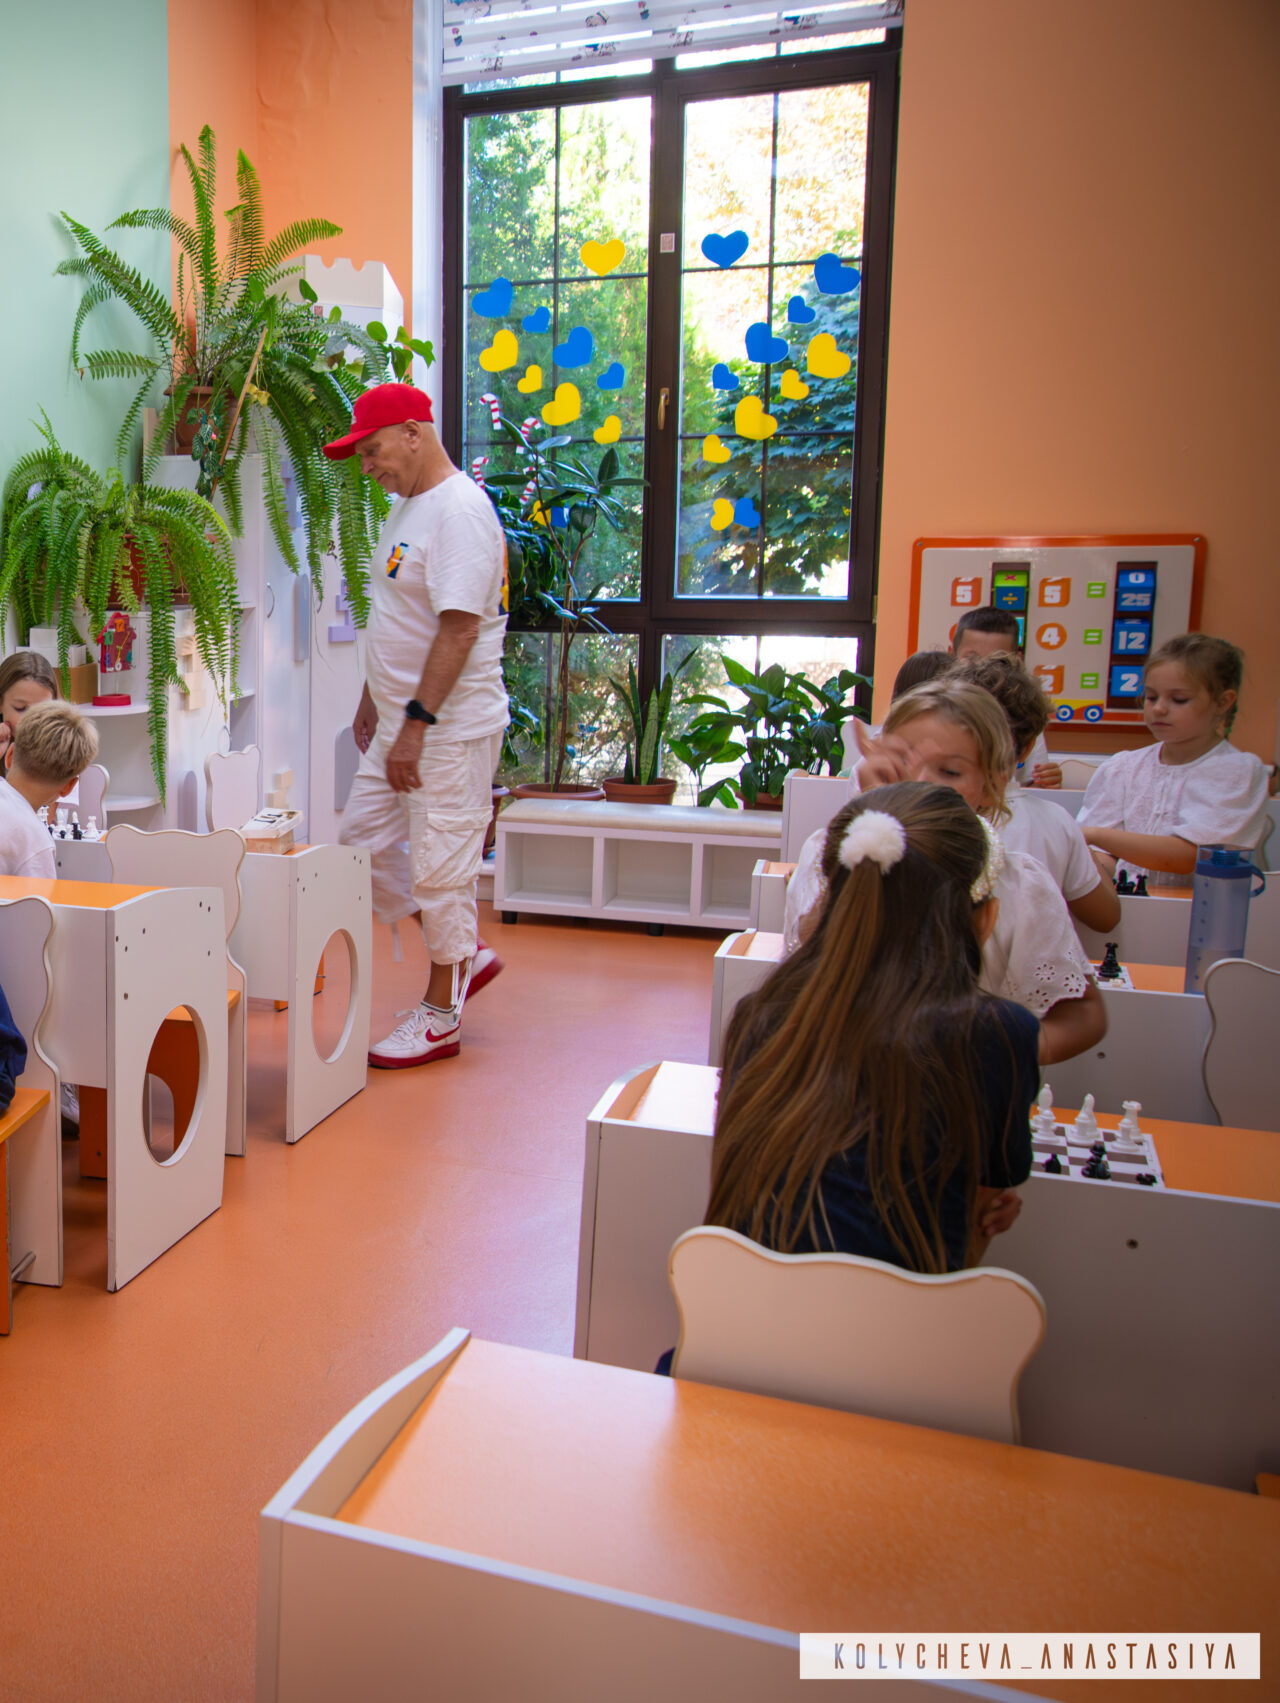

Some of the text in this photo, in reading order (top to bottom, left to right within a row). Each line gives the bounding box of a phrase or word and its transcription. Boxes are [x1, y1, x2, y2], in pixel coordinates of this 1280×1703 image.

[955, 586, 1152, 607] 5 5 25
[1041, 627, 1146, 650] 4 12
[1120, 673, 1139, 692] 2
